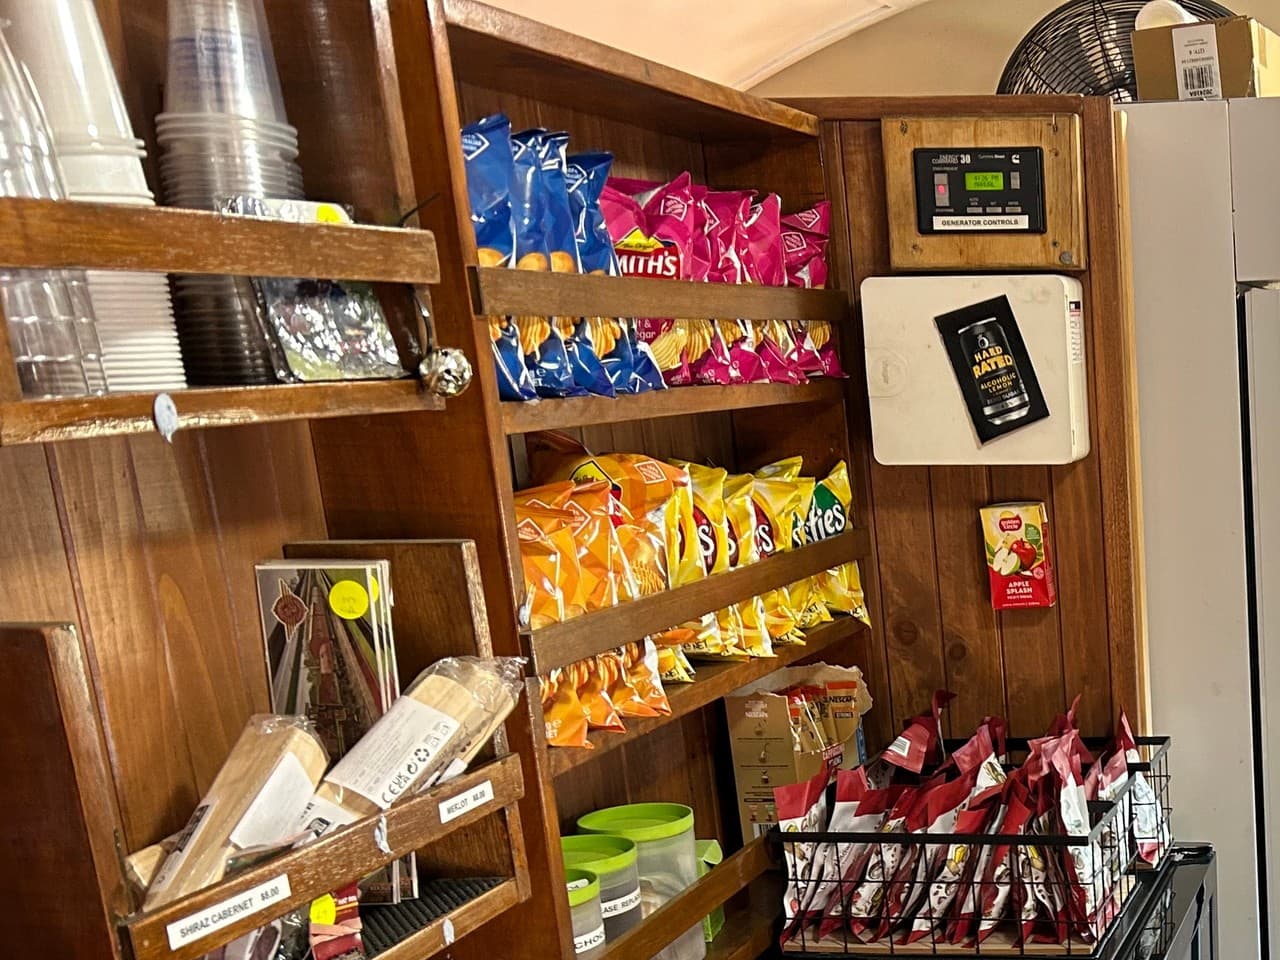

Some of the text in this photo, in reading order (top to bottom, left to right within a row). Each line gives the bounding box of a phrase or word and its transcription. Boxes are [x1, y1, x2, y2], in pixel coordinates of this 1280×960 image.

[974, 346, 1004, 363] HARD
[972, 355, 1014, 379] RATED
[980, 372, 1017, 390] ALCOHOLIC
[988, 381, 1013, 393] LEMON
[1006, 587, 1033, 595] SPLASH
[446, 797, 468, 815] MERLOT
[179, 916, 210, 939] SHIRAZ
[210, 896, 254, 926] CABERNET
